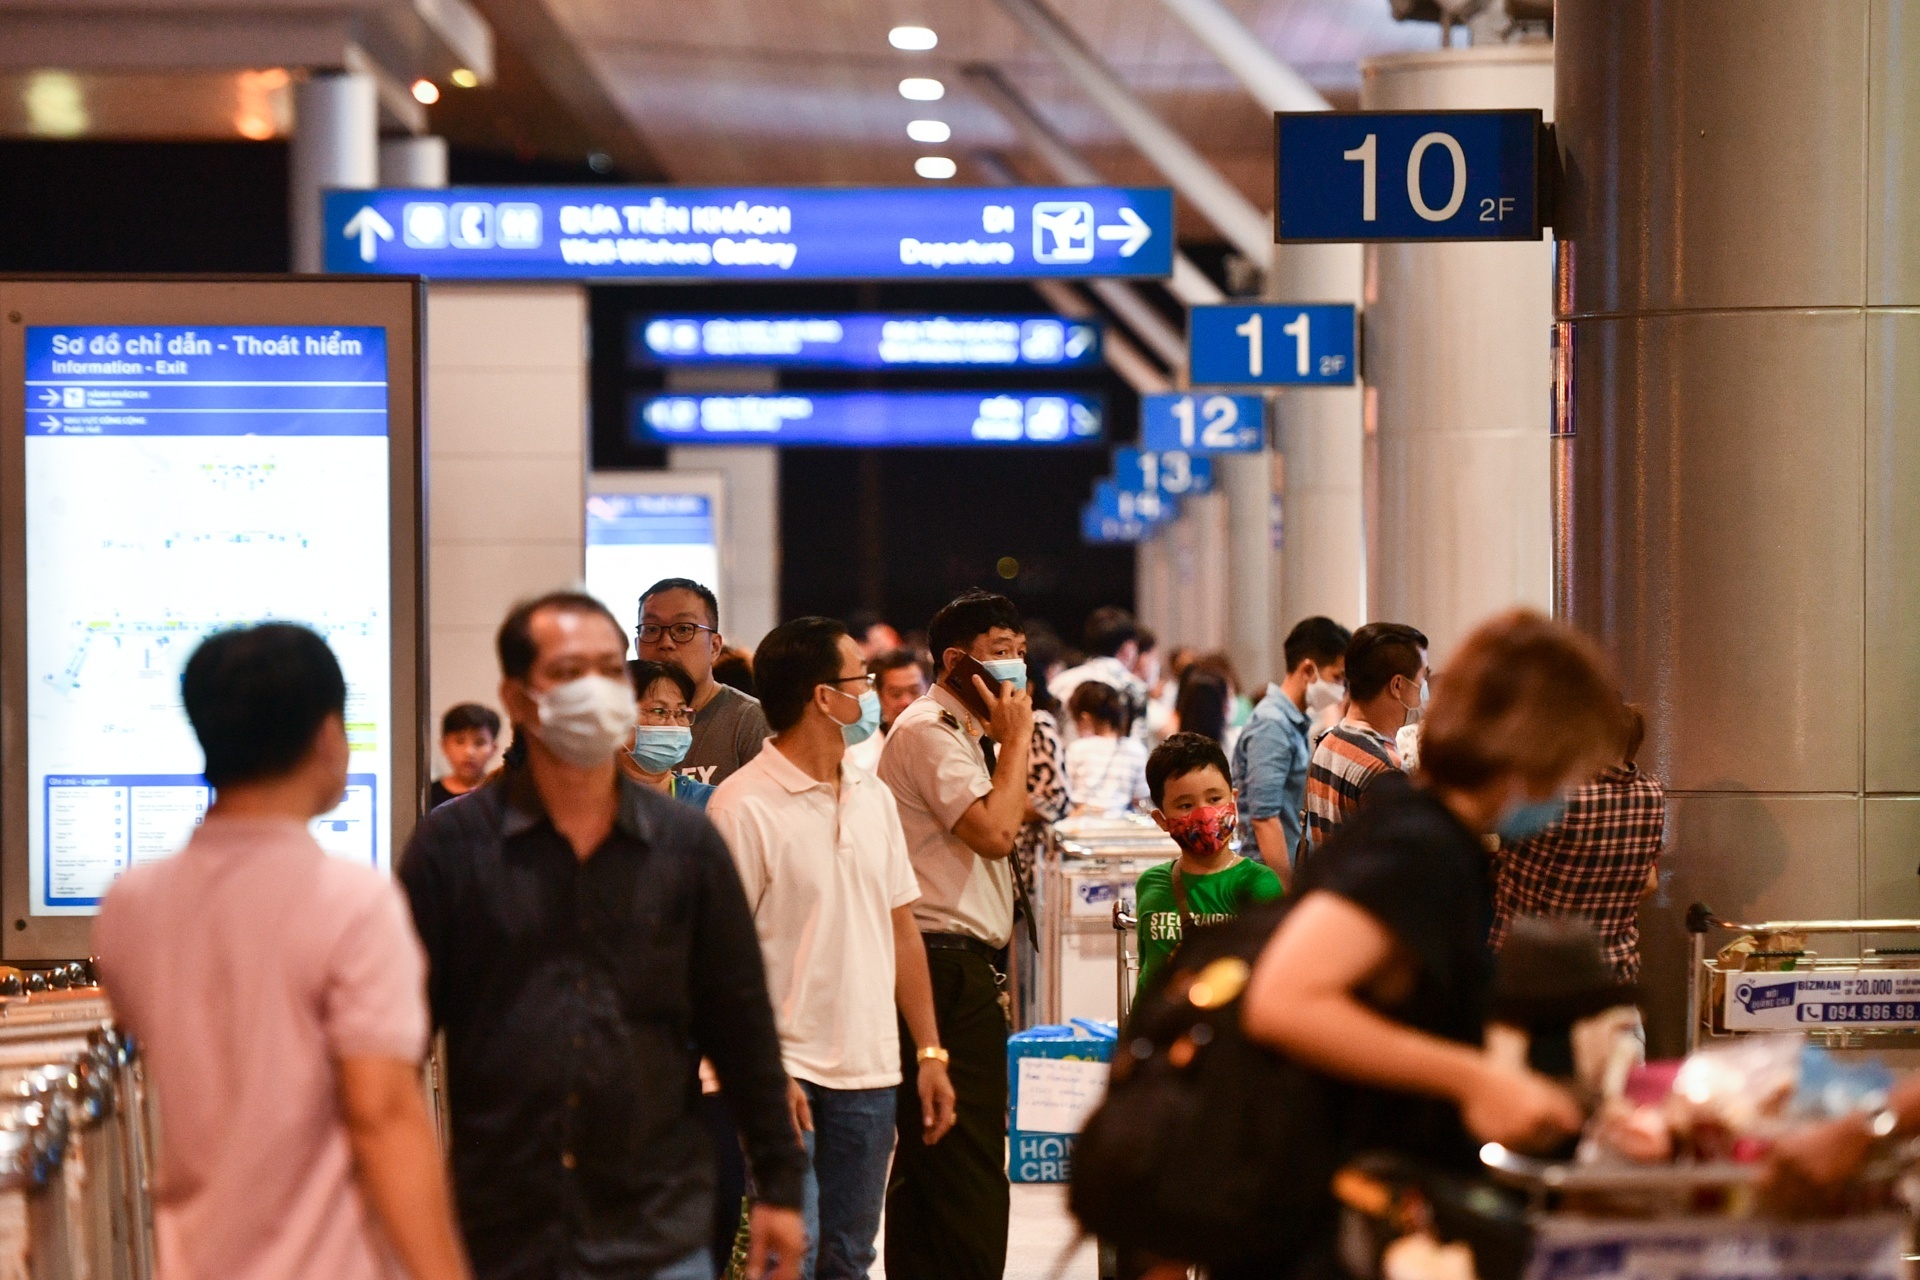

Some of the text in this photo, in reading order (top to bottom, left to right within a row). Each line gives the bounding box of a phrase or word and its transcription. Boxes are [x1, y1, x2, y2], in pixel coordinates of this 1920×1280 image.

[1343, 132, 1516, 221] 10 2F
[52, 334, 86, 355] Sơ
[89, 332, 120, 355] đồ
[125, 332, 163, 355] chỉ
[167, 332, 212, 355] dẫn
[232, 335, 301, 355] Thoát
[305, 331, 363, 355] hiểm
[1236, 313, 1310, 377] 11
[52, 361, 143, 375] Information
[156, 361, 188, 375] Exit
[1170, 396, 1239, 447] 12
[1137, 450, 1192, 493] 13
[1798, 980, 1842, 991] BIZMAN
[1855, 979, 1893, 995] 20.000
